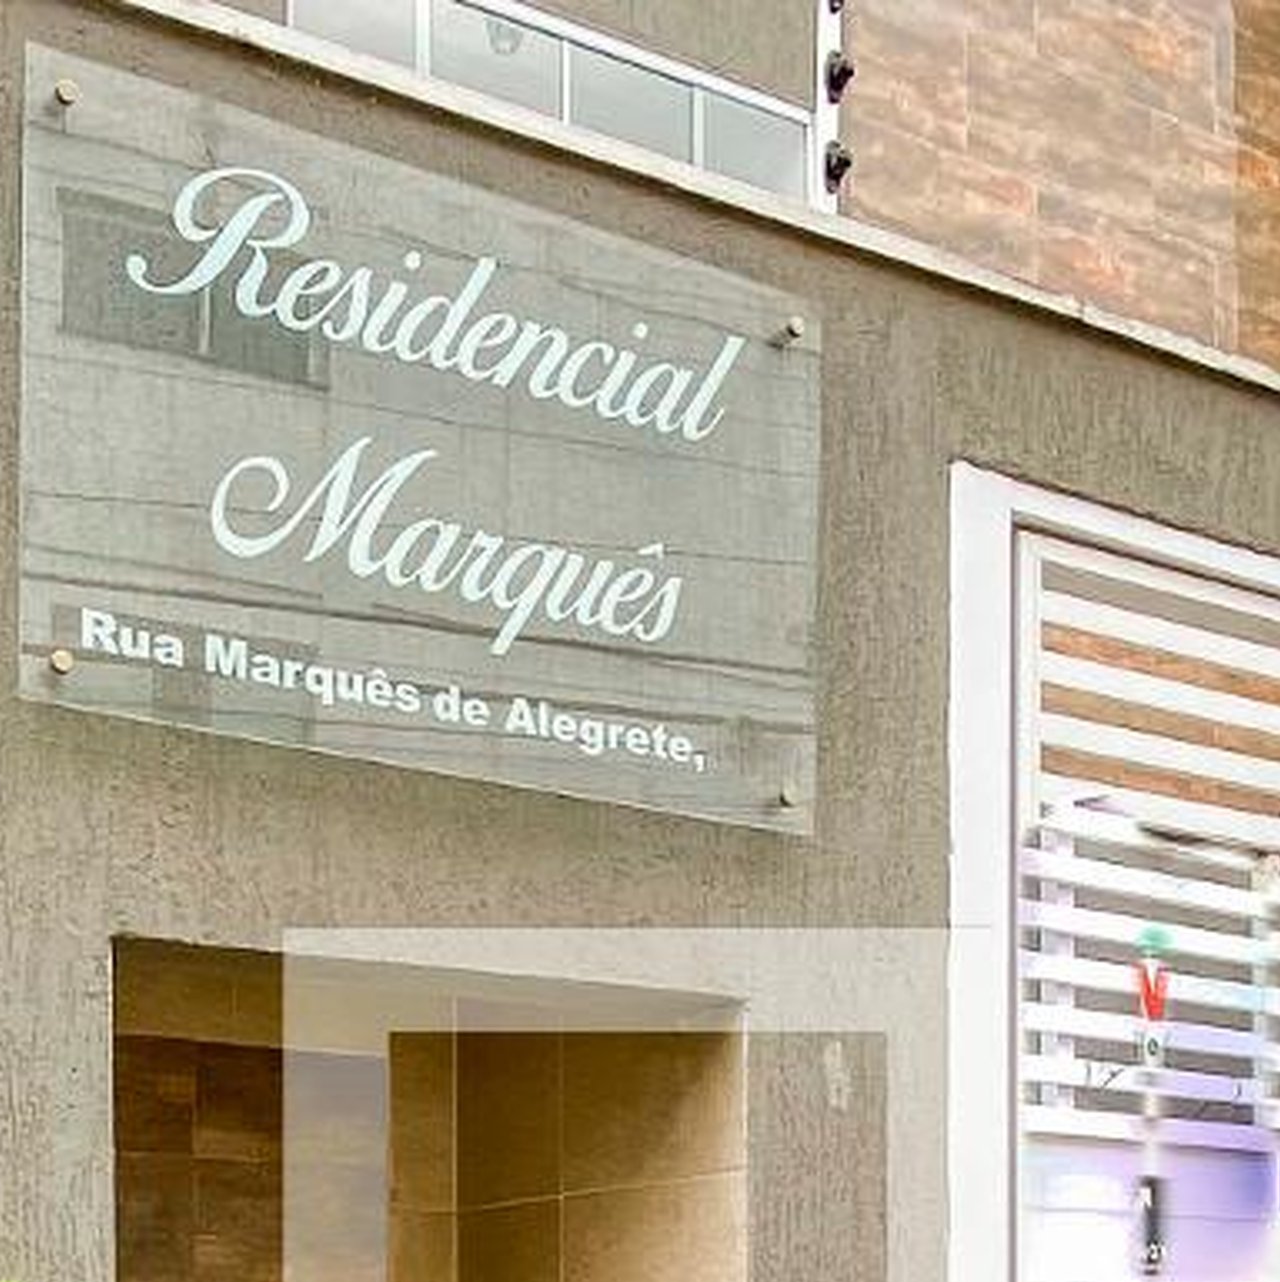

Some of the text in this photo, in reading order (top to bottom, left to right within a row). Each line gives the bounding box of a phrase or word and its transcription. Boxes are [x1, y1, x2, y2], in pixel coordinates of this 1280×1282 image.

[126, 168, 747, 442] Residencial
[210, 436, 684, 655] Marquês
[81, 607, 707, 772] Rua Marquês de Alegrete,
